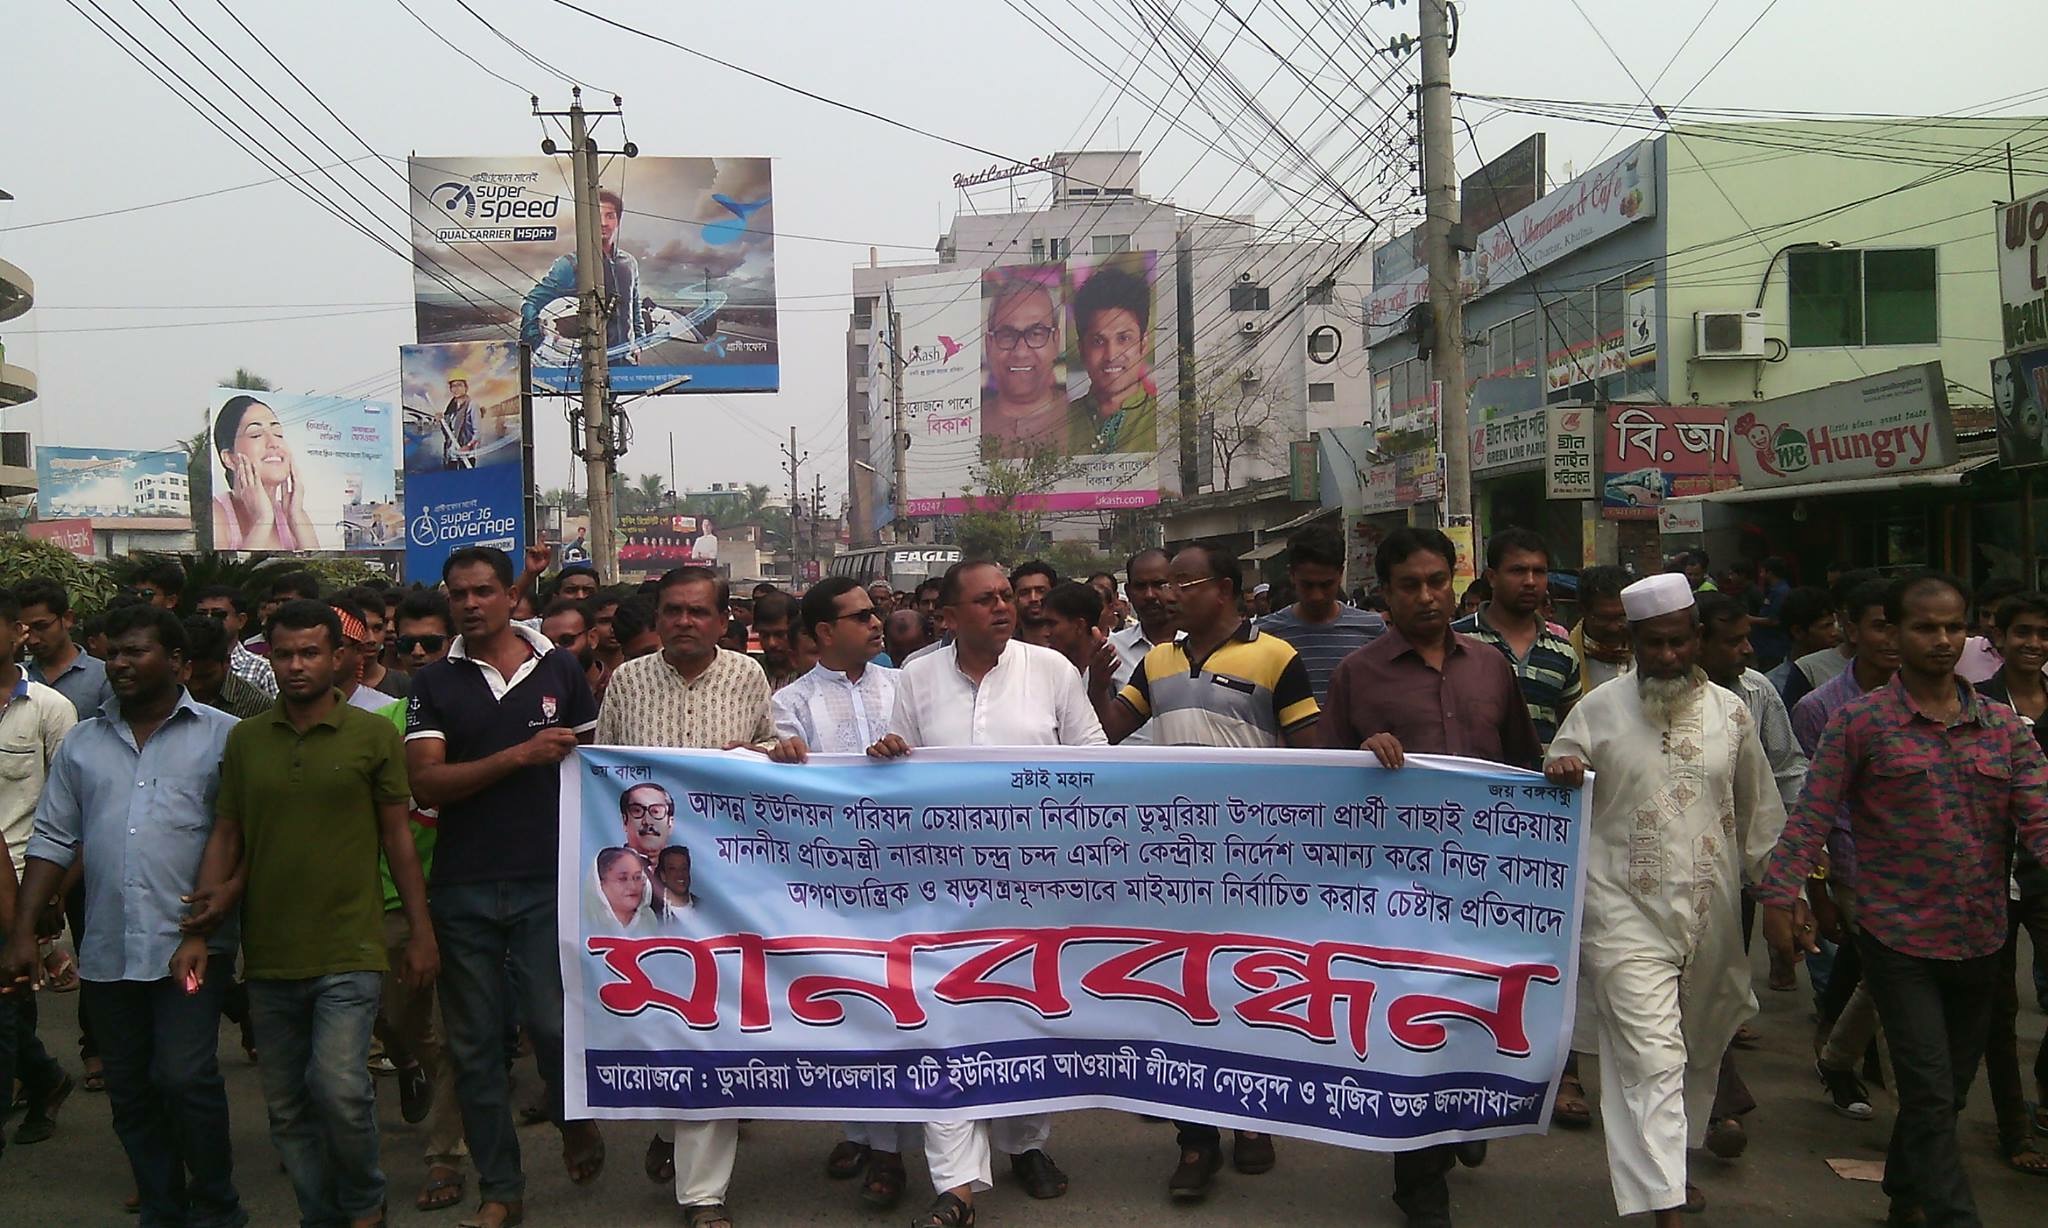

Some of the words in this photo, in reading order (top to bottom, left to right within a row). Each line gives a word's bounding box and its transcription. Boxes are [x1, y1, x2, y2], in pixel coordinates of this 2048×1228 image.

[953, 169, 985, 188] Hotel
[986, 164, 1027, 182] Castle
[476, 184, 526, 200] super
[480, 195, 559, 223] speed
[440, 229, 468, 240] DUAL
[469, 229, 511, 240] CARRIER
[948, 396, 973, 410] পাশে
[926, 413, 973, 436] বিকাশ
[1557, 434, 1586, 450] গ্রীন
[1807, 422, 1931, 468] Hungry
[1554, 451, 1589, 468] লাইন
[1553, 469, 1590, 487] পরিবহন
[440, 511, 474, 526] super
[476, 507, 492, 521] 3G
[917, 501, 940, 512] 16247
[895, 551, 960, 562] EAGLE
[615, 764, 652, 780] বাংলা
[1011, 768, 1051, 789] স্রষ্টাই
[1055, 772, 1095, 789] মহান
[1487, 784, 1517, 799] জয়
[1521, 785, 1574, 808] বঙ্গবন্ধু
[688, 791, 747, 824] আসন্ন
[751, 791, 834, 829] ইউনিয়ন
[842, 797, 913, 832] পরিষদ
[922, 803, 1033, 832] চেয়ারম্যান
[1039, 795, 1129, 832] নির্বাচনে
[1136, 795, 1219, 834] ডুমুরিয়া
[1227, 796, 1327, 831] উপজেলা
[1333, 796, 1388, 832] প্রার্থী
[1396, 798, 1466, 836] বাছাই
[1472, 800, 1572, 845] প্রক্রিয়ায়
[715, 829, 791, 865] মাননীয়
[798, 837, 881, 870] প্রতিমন্ত্রী
[886, 843, 965, 867] নারায়ণ
[971, 845, 1011, 871] চন্দ্র
[1018, 845, 1057, 867] চন্দ
[1067, 836, 1130, 867] এমপি
[1139, 833, 1218, 868] কেন্দ্রীয়
[1223, 832, 1295, 867] নির্দেশ
[1301, 840, 1376, 870] অমান্য
[1384, 845, 1434, 874] করে
[1441, 840, 1490, 882] নিজ
[1496, 853, 1569, 891] বাসায়
[786, 876, 909, 909] অগণতান্ত্রিক
[918, 880, 937, 902] ও
[945, 876, 1117, 911] ষড়যন্ত্রমূলকভাবে
[1124, 872, 1215, 906] মাইম্যান
[1221, 871, 1312, 907] নির্বাচিত
[1318, 882, 1379, 916] করার
[1387, 881, 1453, 924] চেষ্টার
[1460, 889, 1566, 937] প্রতিবাদে
[586, 926, 1561, 1062] মানববন্ধন
[596, 1062, 694, 1092] আয়োজনে
[796, 1057, 898, 1090] উপজেলার
[906, 1056, 942, 1091] ৭টি
[946, 1051, 1047, 1092] ইউনিয়নের
[1051, 1046, 1140, 1082] আওয়ামী
[1146, 1047, 1207, 1091] লীগের
[1213, 1067, 1292, 1112] নেতৃবৃন্দ
[1299, 1081, 1316, 1104] ও
[1323, 1076, 1383, 1119] মুজিব
[1388, 1091, 1429, 1118] ভক্ত
[1434, 1085, 1539, 1118] জনসাধারণ
